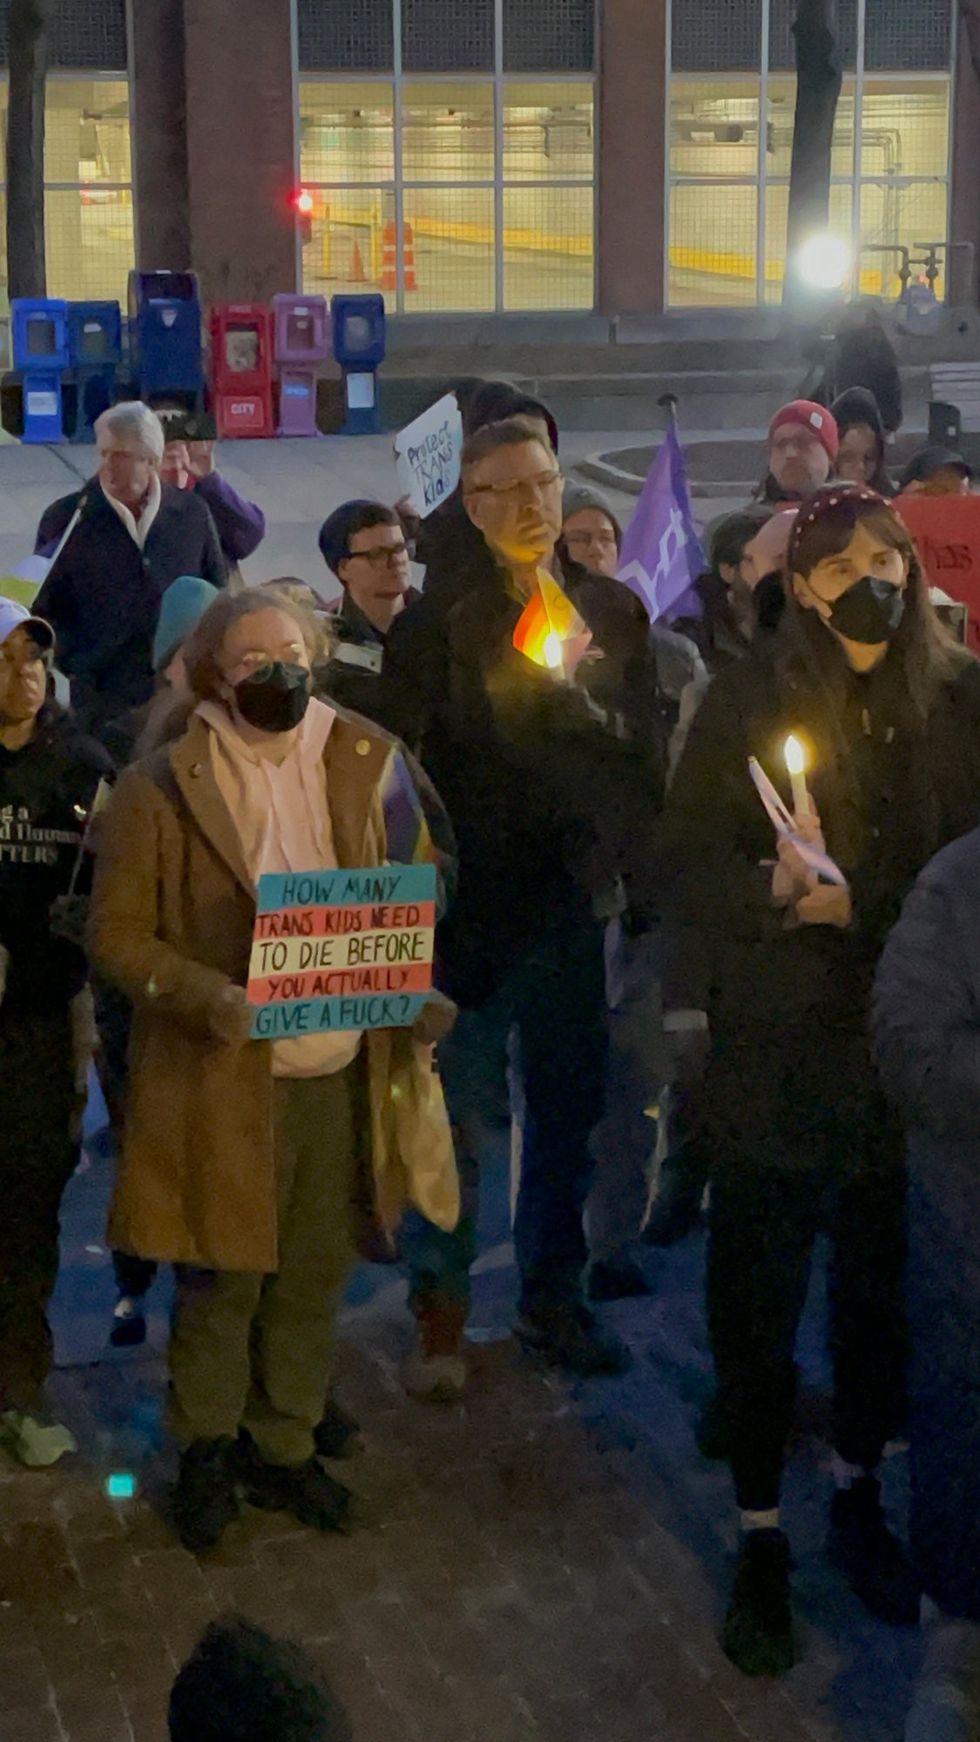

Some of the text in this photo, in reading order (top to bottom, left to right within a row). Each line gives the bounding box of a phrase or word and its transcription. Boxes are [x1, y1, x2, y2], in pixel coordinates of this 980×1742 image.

[230, 403, 255, 415] CITY
[281, 875, 402, 904] HOW MANY
[257, 906, 420, 938] TRANS KIDS NEED
[259, 932, 425, 973] TO DIE BEFORE
[267, 969, 411, 1000] YOU ACTUALLY
[256, 996, 411, 1035] GIVE A FUCK?
